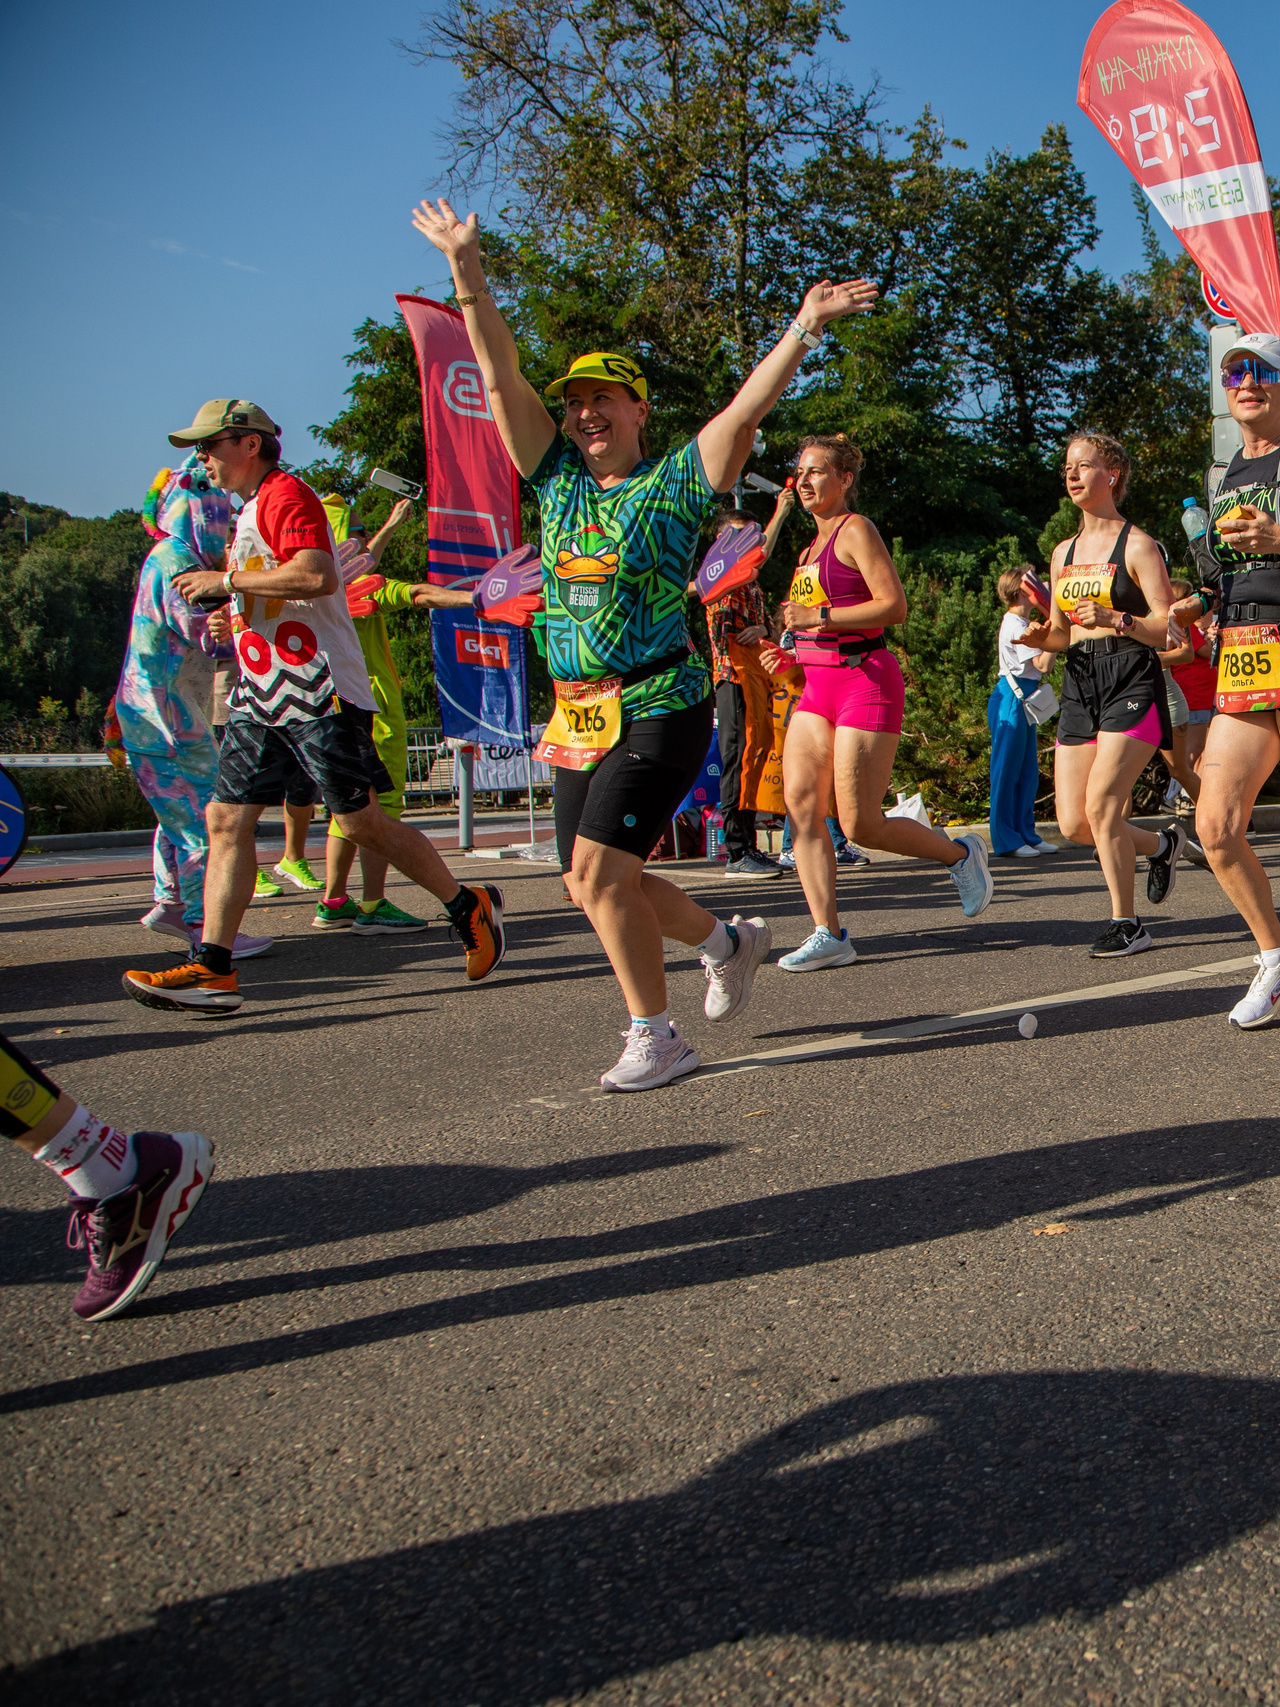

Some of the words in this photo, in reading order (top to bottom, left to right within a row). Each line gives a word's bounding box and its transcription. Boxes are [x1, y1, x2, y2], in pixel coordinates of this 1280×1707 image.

[569, 584, 600, 595] MYTISCHI
[1062, 580, 1102, 600] 6000
[569, 592, 600, 607] BEGOOD
[1223, 650, 1272, 678] 7885
[1231, 679, 1256, 688] ОЛЬГА
[1219, 694, 1225, 709] G
[542, 744, 558, 759] E
